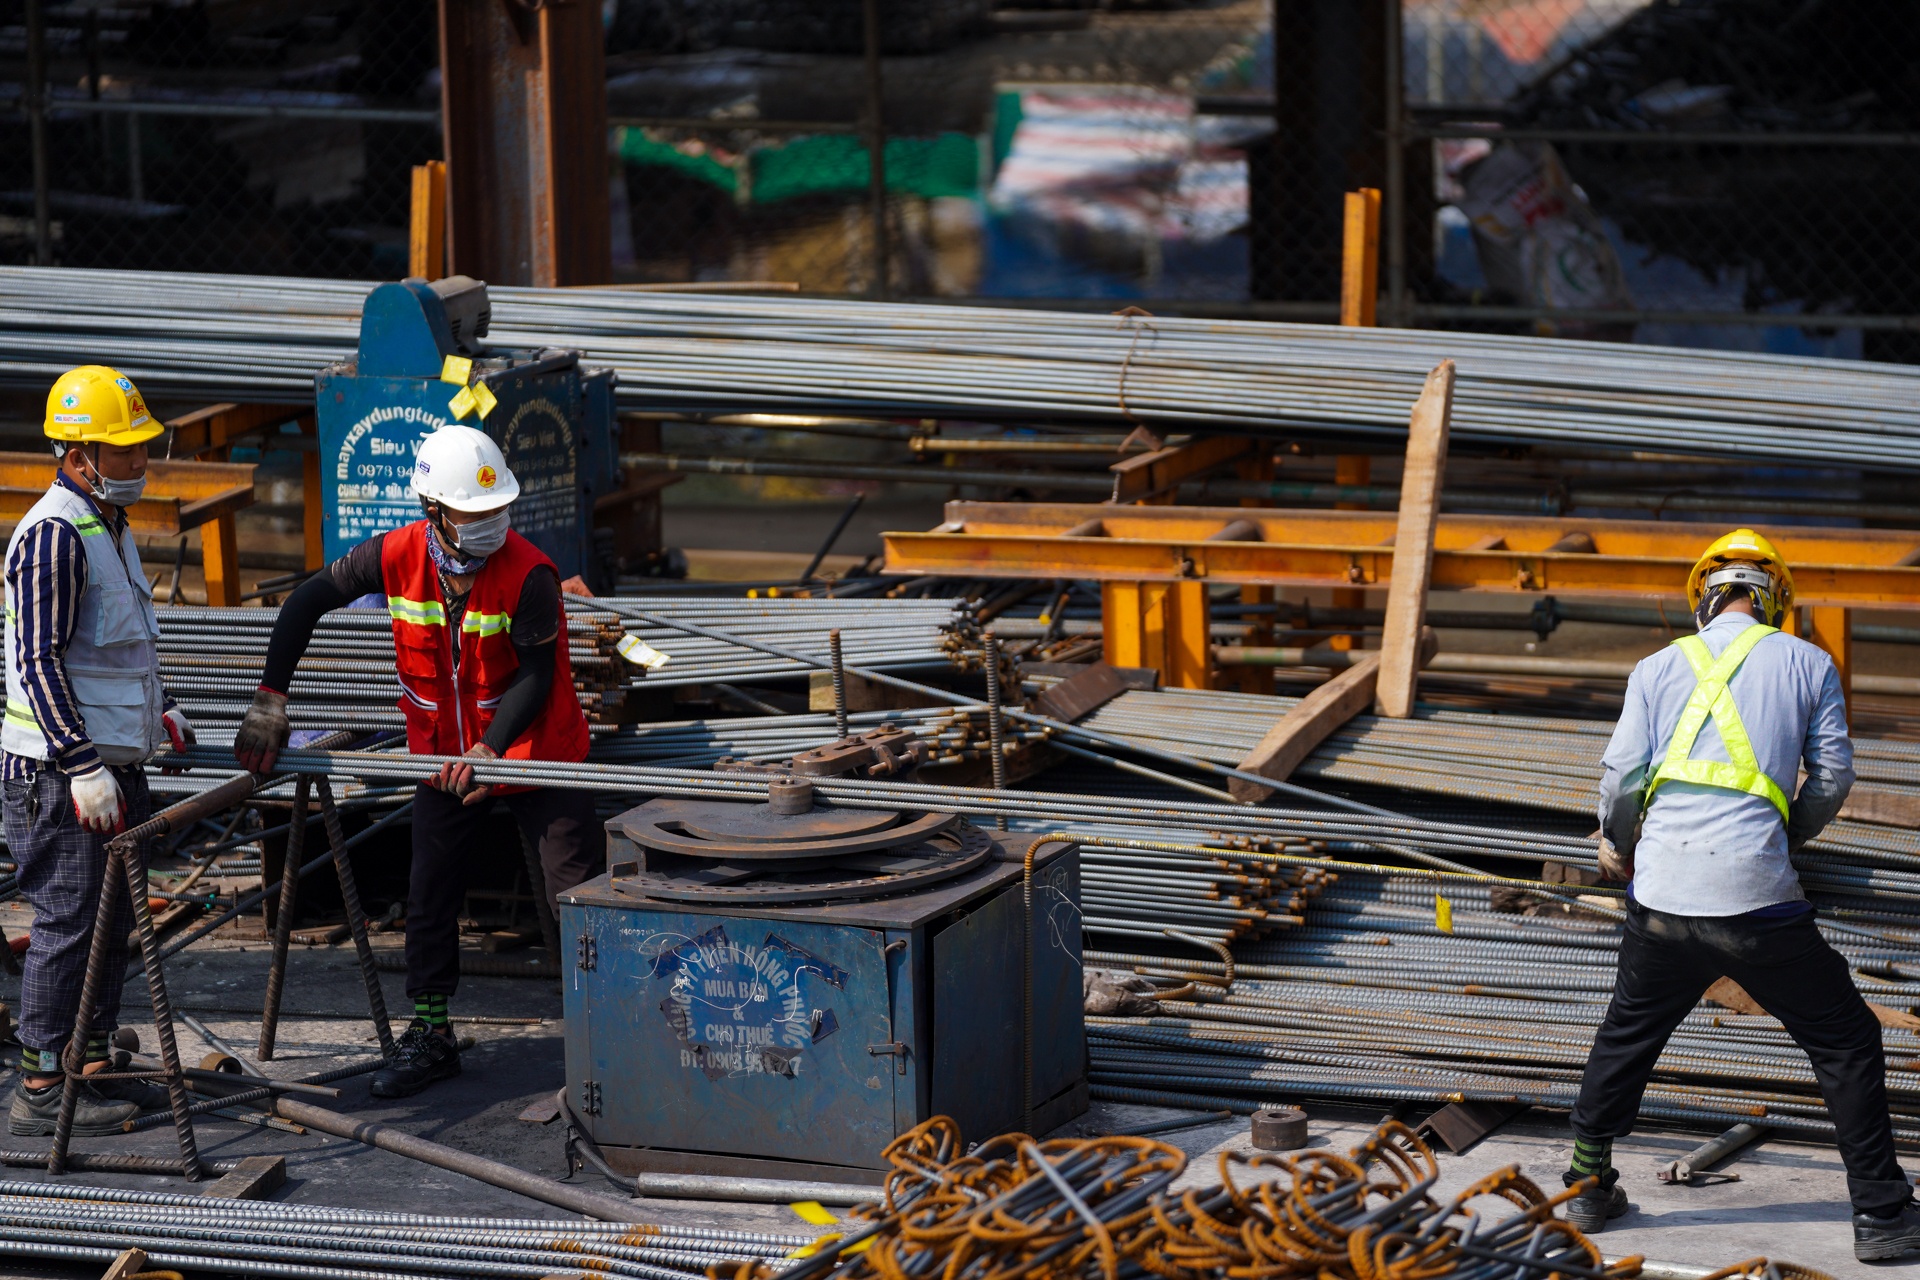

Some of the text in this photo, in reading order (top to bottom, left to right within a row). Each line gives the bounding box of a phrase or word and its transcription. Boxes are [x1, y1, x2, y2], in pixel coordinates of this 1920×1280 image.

[337, 406, 447, 480] mayxaydungtud
[370, 437, 422, 457] Siêu V
[357, 464, 393, 478] 0978
[396, 465, 414, 478] 94
[337, 483, 360, 498] CUNG
[404, 485, 419, 499] CH
[704, 979, 735, 998] MUA
[739, 977, 769, 1001] BÁN
[732, 1003, 745, 1021] &
[705, 1023, 734, 1042] CHO
[736, 1021, 775, 1046] THUÊ
